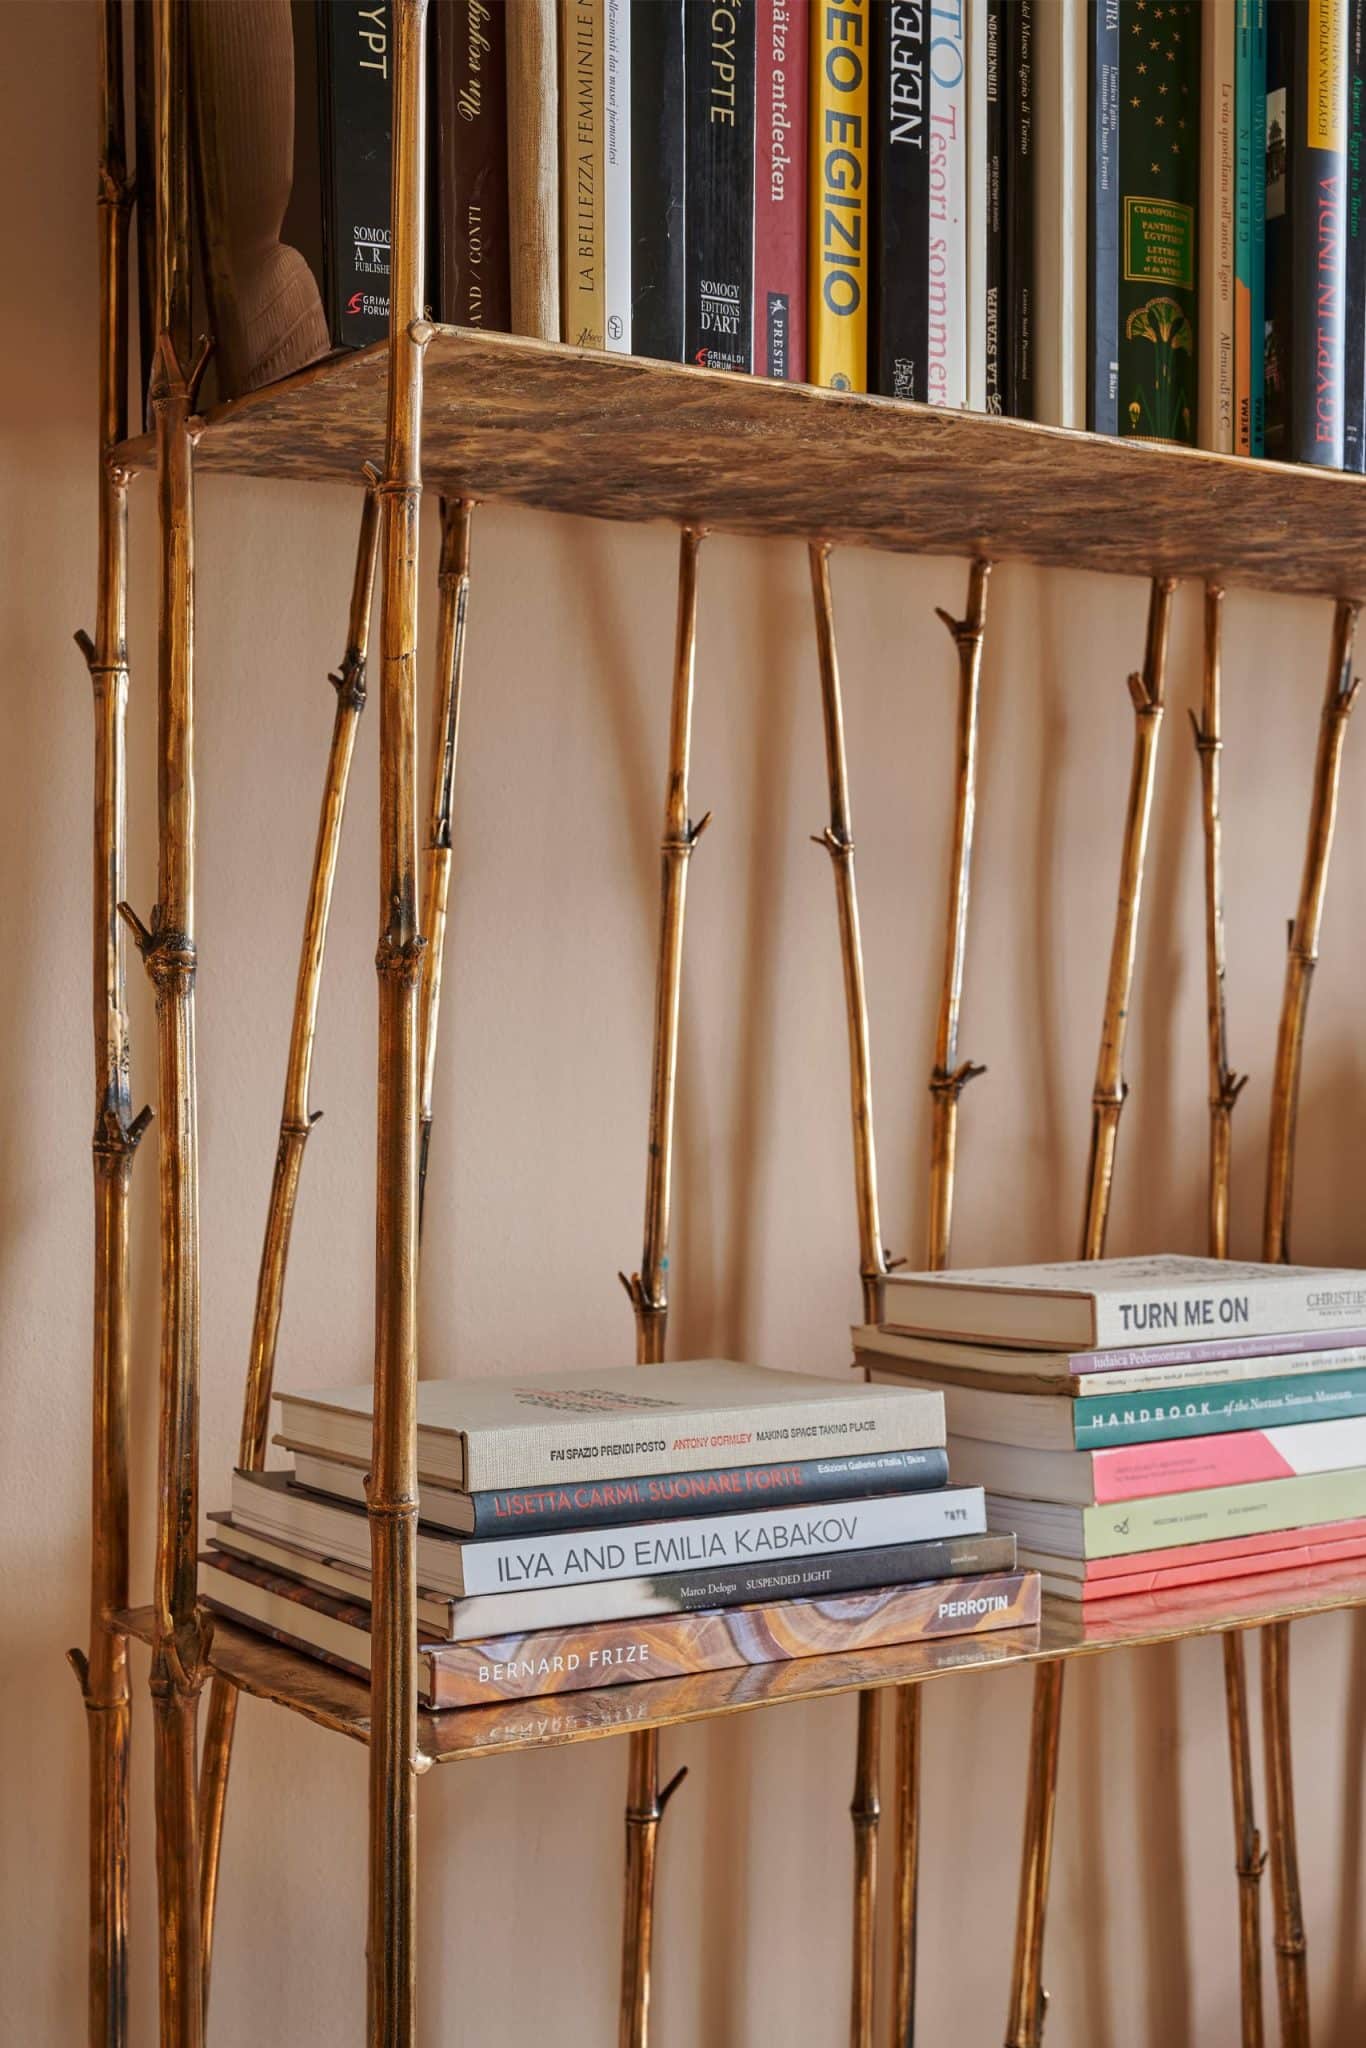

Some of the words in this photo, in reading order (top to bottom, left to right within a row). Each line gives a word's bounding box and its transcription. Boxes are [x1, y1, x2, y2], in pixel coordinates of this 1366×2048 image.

[986, 13, 998, 103] TUTANKHAMON
[1020, 21, 1031, 60] Museo
[577, 15, 594, 145] FEMMINILE
[608, 54, 619, 74] dai
[890, 0, 923, 149] NEFE
[1018, 63, 1031, 98] Egizio
[457, 79, 481, 122] Un
[608, 75, 619, 107] musei
[1101, 64, 1110, 112] illuminato
[1110, 66, 1119, 102] L'antico
[1222, 82, 1232, 98] La
[1318, 69, 1329, 137] EGYPTIAN
[1352, 75, 1362, 127] Ancient
[1021, 101, 1031, 113] di
[1101, 113, 1110, 125] da
[1109, 103, 1119, 131] Egitto
[1221, 101, 1231, 124] vita
[606, 107, 619, 166] piemontesi
[771, 69, 791, 202] entdecken
[1020, 117, 1031, 155] Torino
[1101, 127, 1110, 154] Dante
[1350, 131, 1362, 170] Egypt
[930, 104, 958, 223] Tesori
[1101, 155, 1110, 191] Ferretti
[1218, 127, 1231, 193] quotidiana
[1239, 129, 1249, 242] GEBELEIN
[1351, 177, 1361, 191] in
[577, 153, 594, 257] BELLEZZA
[823, 109, 862, 317] EGIZIO
[1317, 175, 1341, 273] INDIA
[1351, 196, 1361, 238] Torino
[468, 205, 482, 264] CONTI
[1221, 196, 1231, 259] nell'antico
[579, 267, 594, 292] LA
[700, 280, 740, 298] SOMOGY
[1218, 263, 1231, 301] Egitto
[1317, 281, 1338, 319] IN
[701, 312, 740, 334] D'ART
[987, 286, 998, 355] STAMPA
[707, 351, 744, 364] GRIMALDI
[707, 360, 732, 370] FORUM
[773, 320, 784, 377] PRESTE
[1220, 332, 1231, 395] Allemandi
[987, 361, 998, 385] LA
[1315, 327, 1337, 443] EGYPT
[1119, 1302, 1178, 1330] TURN
[1184, 1300, 1214, 1326] ME
[1219, 1296, 1249, 1323] ON
[1093, 1354, 1128, 1369] Judaica
[1092, 1402, 1212, 1429] HANDBOOK
[1223, 1400, 1234, 1416] of
[1234, 1399, 1249, 1412] the
[1284, 1392, 1313, 1405] Simon
[1315, 1390, 1352, 1401] Museum
[550, 1450, 565, 1461] FAI
[566, 1446, 599, 1460] SPAZIO
[600, 1443, 634, 1457] PRENDI
[635, 1440, 666, 1453] POSTO
[672, 1436, 709, 1450] ANTONY
[710, 1433, 752, 1448] GORMLEY
[756, 1428, 789, 1442] MAKING
[790, 1426, 817, 1439] SPACE
[818, 1423, 848, 1436] TAKING
[849, 1420, 876, 1433] PLACE
[817, 1463, 848, 1473] Edizioni
[495, 1491, 573, 1517] LISETTA
[575, 1485, 645, 1509] CARMI.
[650, 1472, 742, 1502] SUONARE
[746, 1466, 804, 1489] FORTE
[497, 1553, 554, 1582] ILYA
[564, 1544, 625, 1575] AND
[634, 1532, 727, 1566] EMILIA
[735, 1516, 858, 1554] KABAKOV
[680, 1587, 706, 1598] Marco
[708, 1583, 737, 1595] Delogu
[745, 1574, 800, 1591] SUSPENDED
[802, 1570, 832, 1583] LIGHT
[939, 1595, 1008, 1619] PERROTIN
[479, 1654, 580, 1683] BERNARD
[589, 1644, 649, 1669] FRIZE
